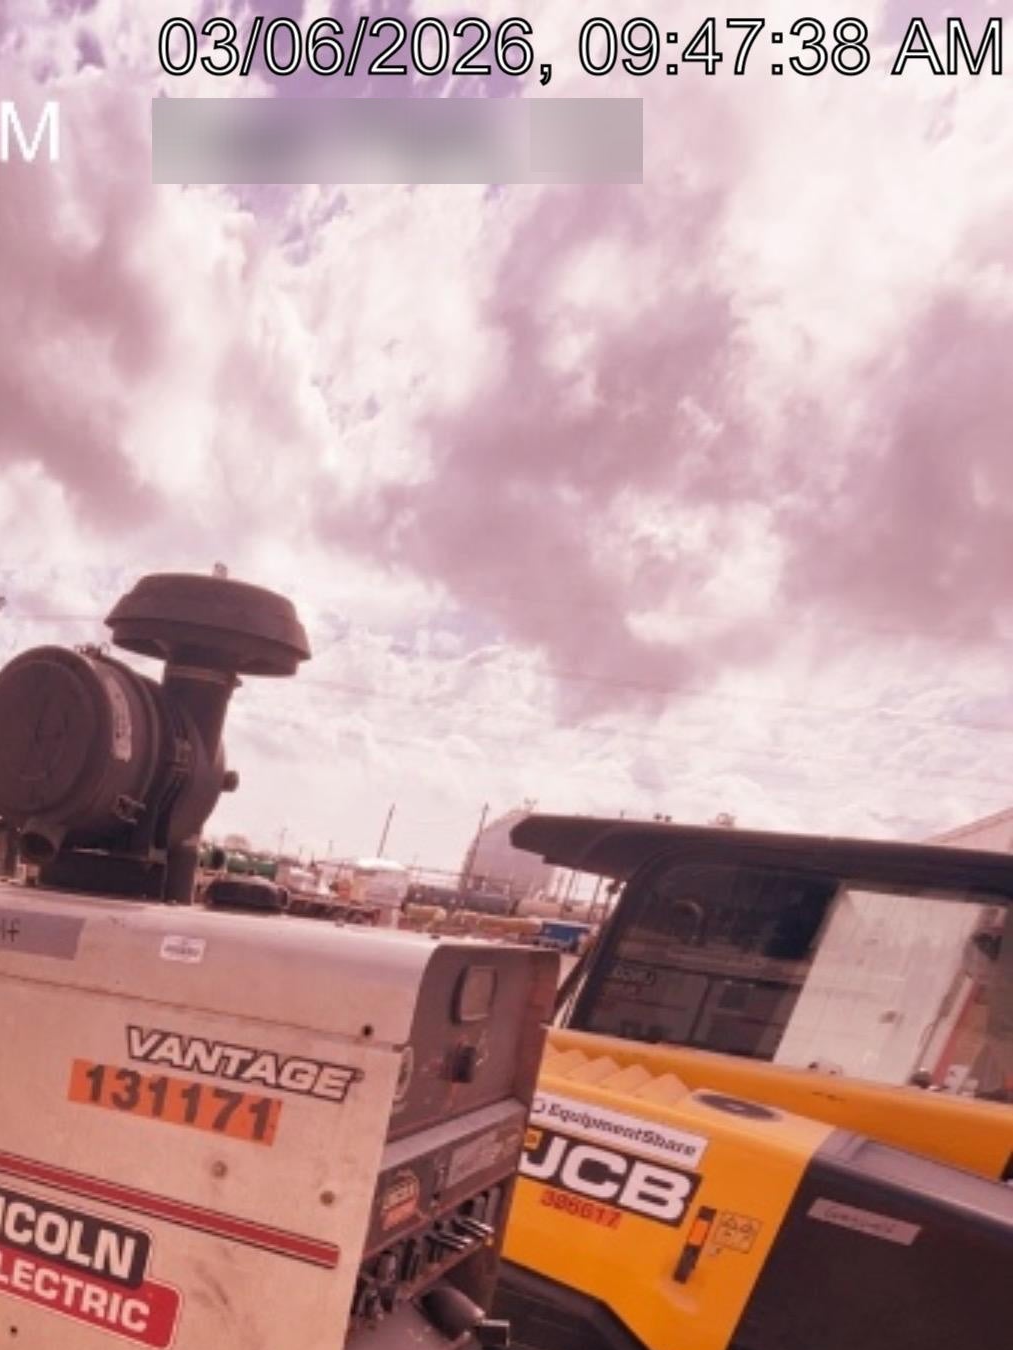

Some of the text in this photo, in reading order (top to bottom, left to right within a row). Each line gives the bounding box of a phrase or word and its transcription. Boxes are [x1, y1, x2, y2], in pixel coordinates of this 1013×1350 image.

[86, 1064, 272, 1141] 131171
[126, 1025, 358, 1103] VANTAGE
[548, 1102, 697, 1158] EquipmentShare
[518, 1135, 692, 1221] JCB
